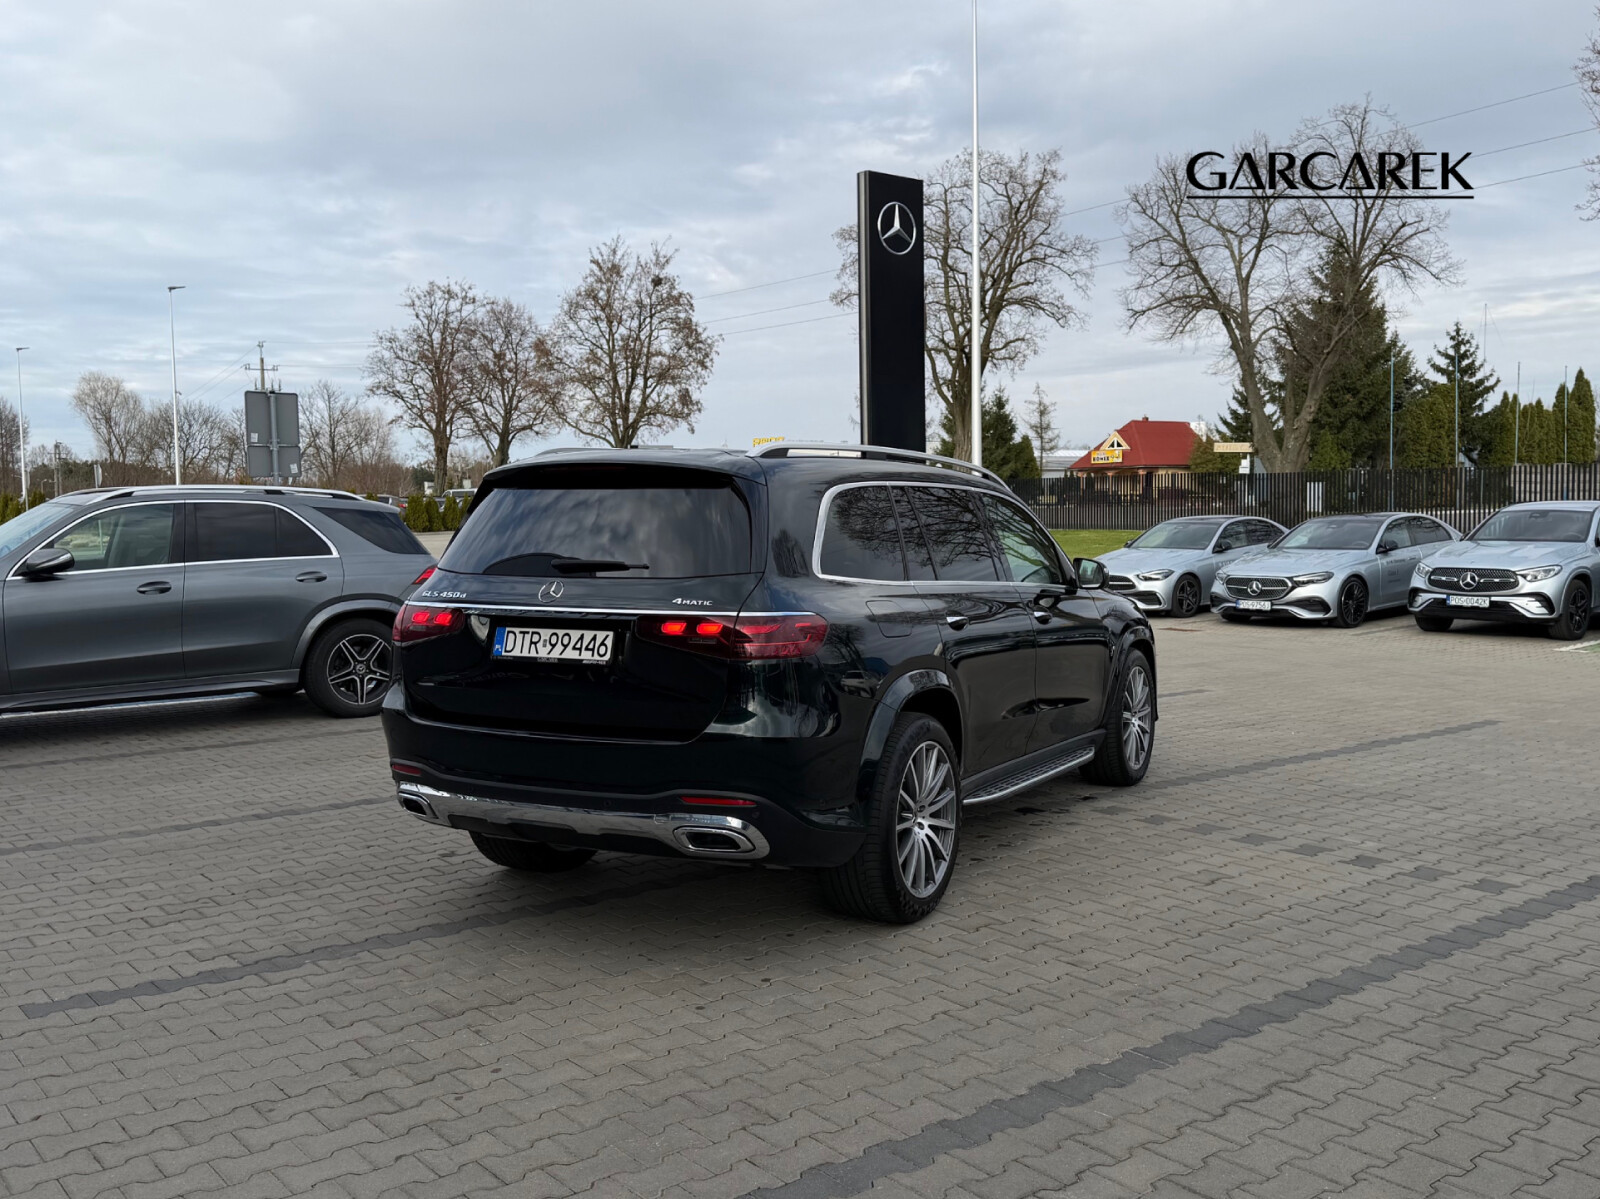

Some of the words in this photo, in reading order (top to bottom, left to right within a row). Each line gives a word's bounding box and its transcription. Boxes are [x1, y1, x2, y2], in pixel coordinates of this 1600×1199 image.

[422, 590, 439, 598] GLS
[671, 597, 713, 606] 4MATIC
[504, 630, 542, 655] DTR
[547, 632, 610, 658] 99446
